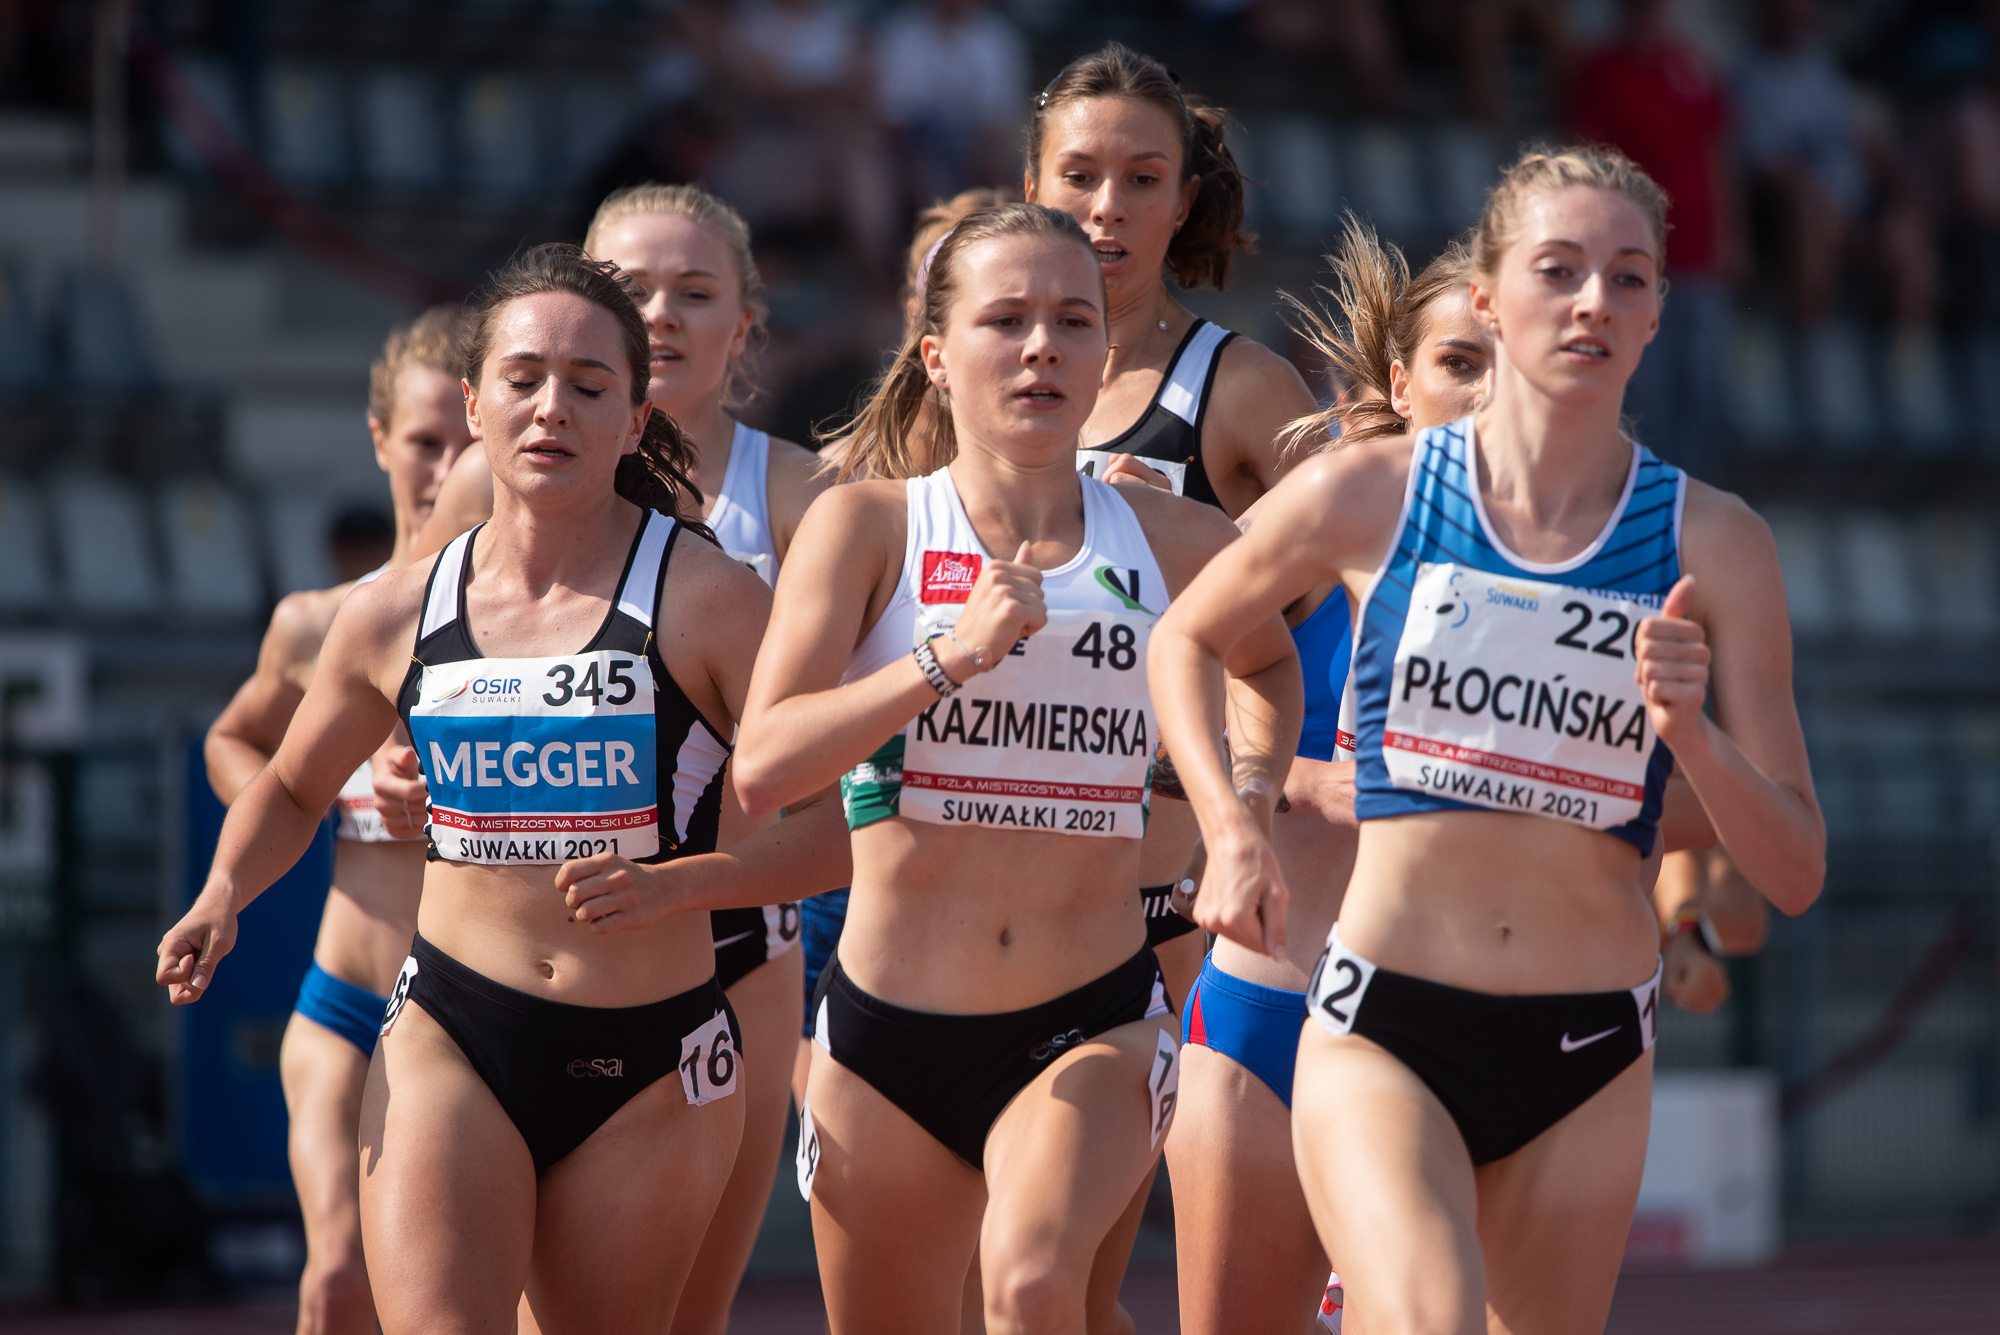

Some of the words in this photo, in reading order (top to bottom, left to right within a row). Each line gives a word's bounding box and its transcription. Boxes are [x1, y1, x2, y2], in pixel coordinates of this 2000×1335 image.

[928, 561, 974, 582] Anwil
[1071, 621, 1137, 672] 48
[1555, 601, 1637, 662] 22
[472, 678, 522, 694] OSIR
[542, 660, 637, 707] 345
[1402, 655, 1647, 753] PŁOCIŃSKA
[916, 696, 1147, 758] KAZIMIERSKA
[429, 740, 640, 788] MEGGER
[937, 777, 974, 789] PZLA
[976, 780, 1076, 797] MISTRZOSTWA
[1078, 786, 1119, 799] POLSKI
[941, 799, 1057, 829] SUWAŁKI
[1064, 808, 1116, 833] 2021
[1417, 765, 1535, 810] SUWAŁKI
[1540, 791, 1599, 823] 2021
[438, 812, 454, 825] 38.
[454, 816, 478, 829] PZLA
[480, 819, 573, 829] MISTRZOSTWA
[575, 818, 621, 829] POLSKI
[623, 813, 651, 826] U23
[459, 837, 556, 861] SUWAŁKI
[564, 837, 619, 860] 2021
[1311, 941, 1363, 1024] 12
[681, 1029, 735, 1100] 16
